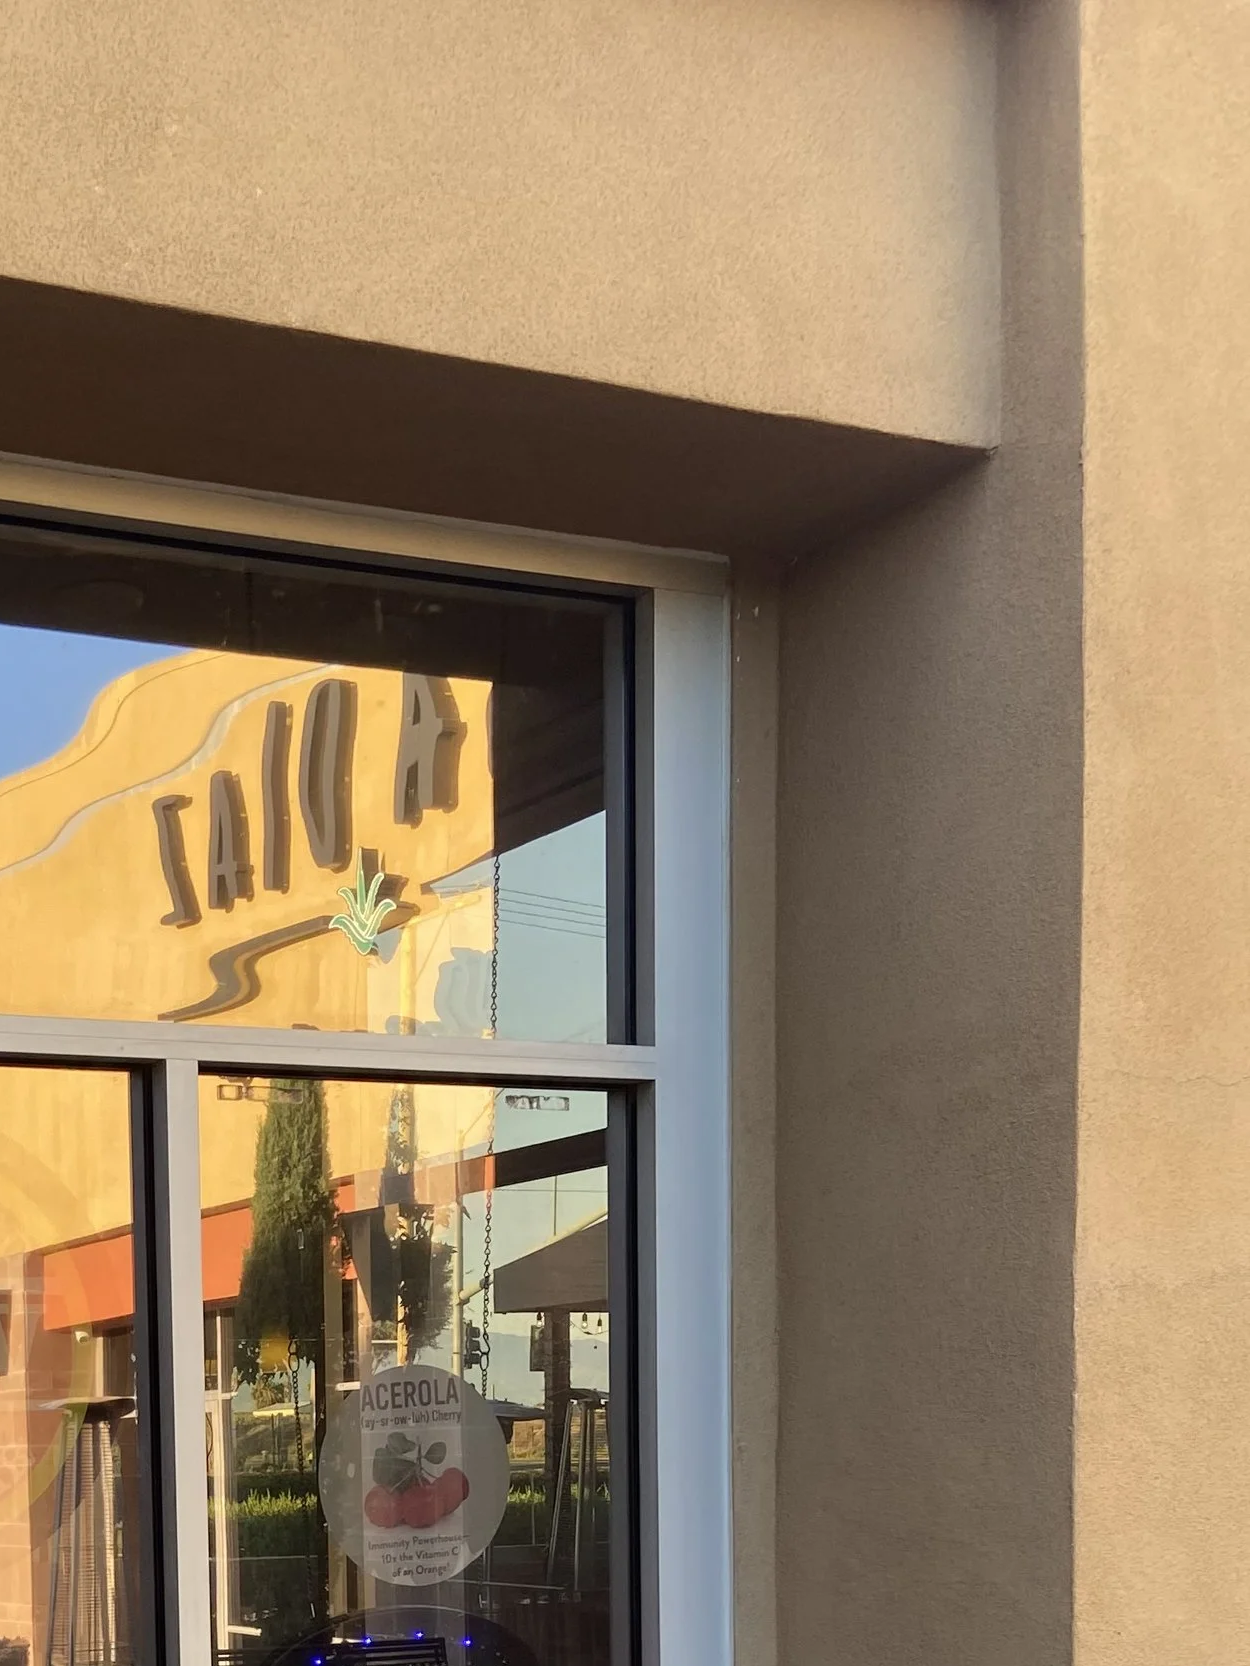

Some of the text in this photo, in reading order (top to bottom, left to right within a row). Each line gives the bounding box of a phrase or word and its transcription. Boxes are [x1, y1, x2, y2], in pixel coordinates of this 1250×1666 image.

[361, 1377, 460, 1412] ACEROLA
[431, 1409, 462, 1424] Cherry
[368, 1538, 410, 1550] Immunity
[382, 1546, 459, 1564] 10x the Vitamin C
[392, 1567, 402, 1578] of
[403, 1568, 414, 1576] an
